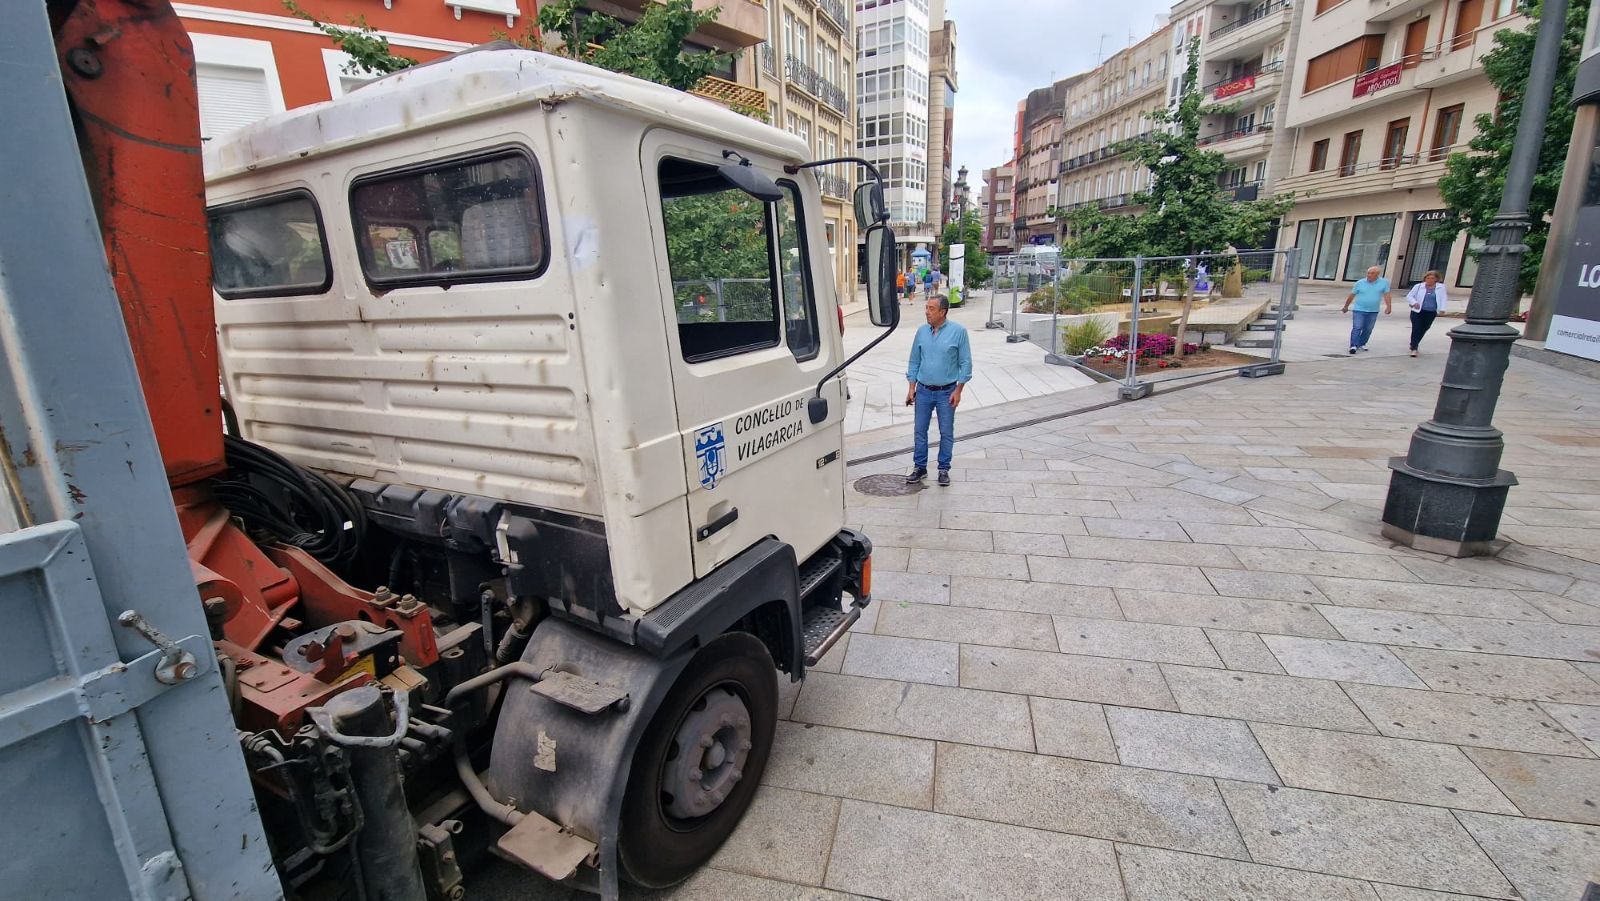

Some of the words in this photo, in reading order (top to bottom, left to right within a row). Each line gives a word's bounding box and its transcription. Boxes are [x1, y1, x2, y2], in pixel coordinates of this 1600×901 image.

[1417, 212, 1446, 220] ZARA
[736, 401, 792, 434] CONCELLO
[796, 398, 804, 411] DE
[738, 420, 804, 461] VILAGARCIA
